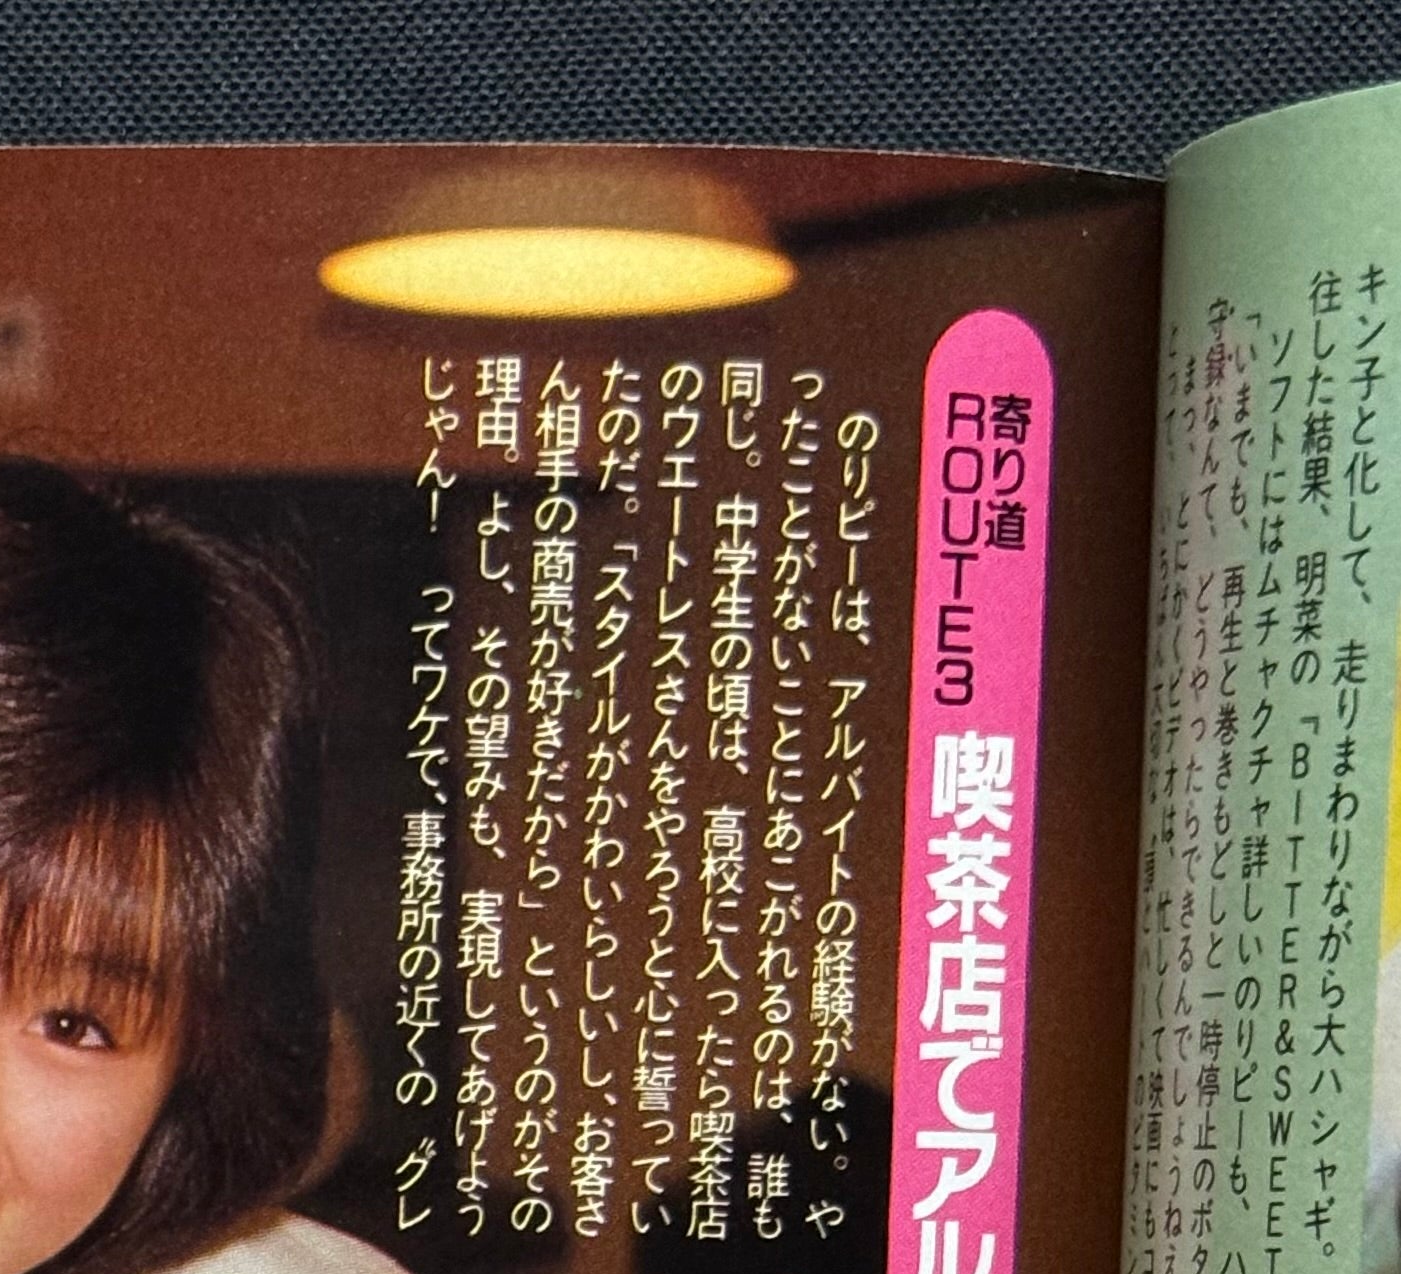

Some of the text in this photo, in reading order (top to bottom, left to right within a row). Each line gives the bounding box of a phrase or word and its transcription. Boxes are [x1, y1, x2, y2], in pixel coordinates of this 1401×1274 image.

[455, 357, 521, 1235] 理由。よし、その望みも、実現してあげよう
[511, 360, 581, 1232] ん相手の商売が好きだから」というのがその
[632, 365, 703, 1234] のウエートレスさんをやろうと心に誓ってい
[687, 360, 763, 1241] 同じ。中学生の頃は、高校に入ったら喫茶店
[747, 371, 824, 1238] ったことがないことにあこがれるのは、誰も
[805, 414, 879, 1239] のりピーは、アルバイトの経験がない。や
[984, 392, 1032, 551] 寄り道
